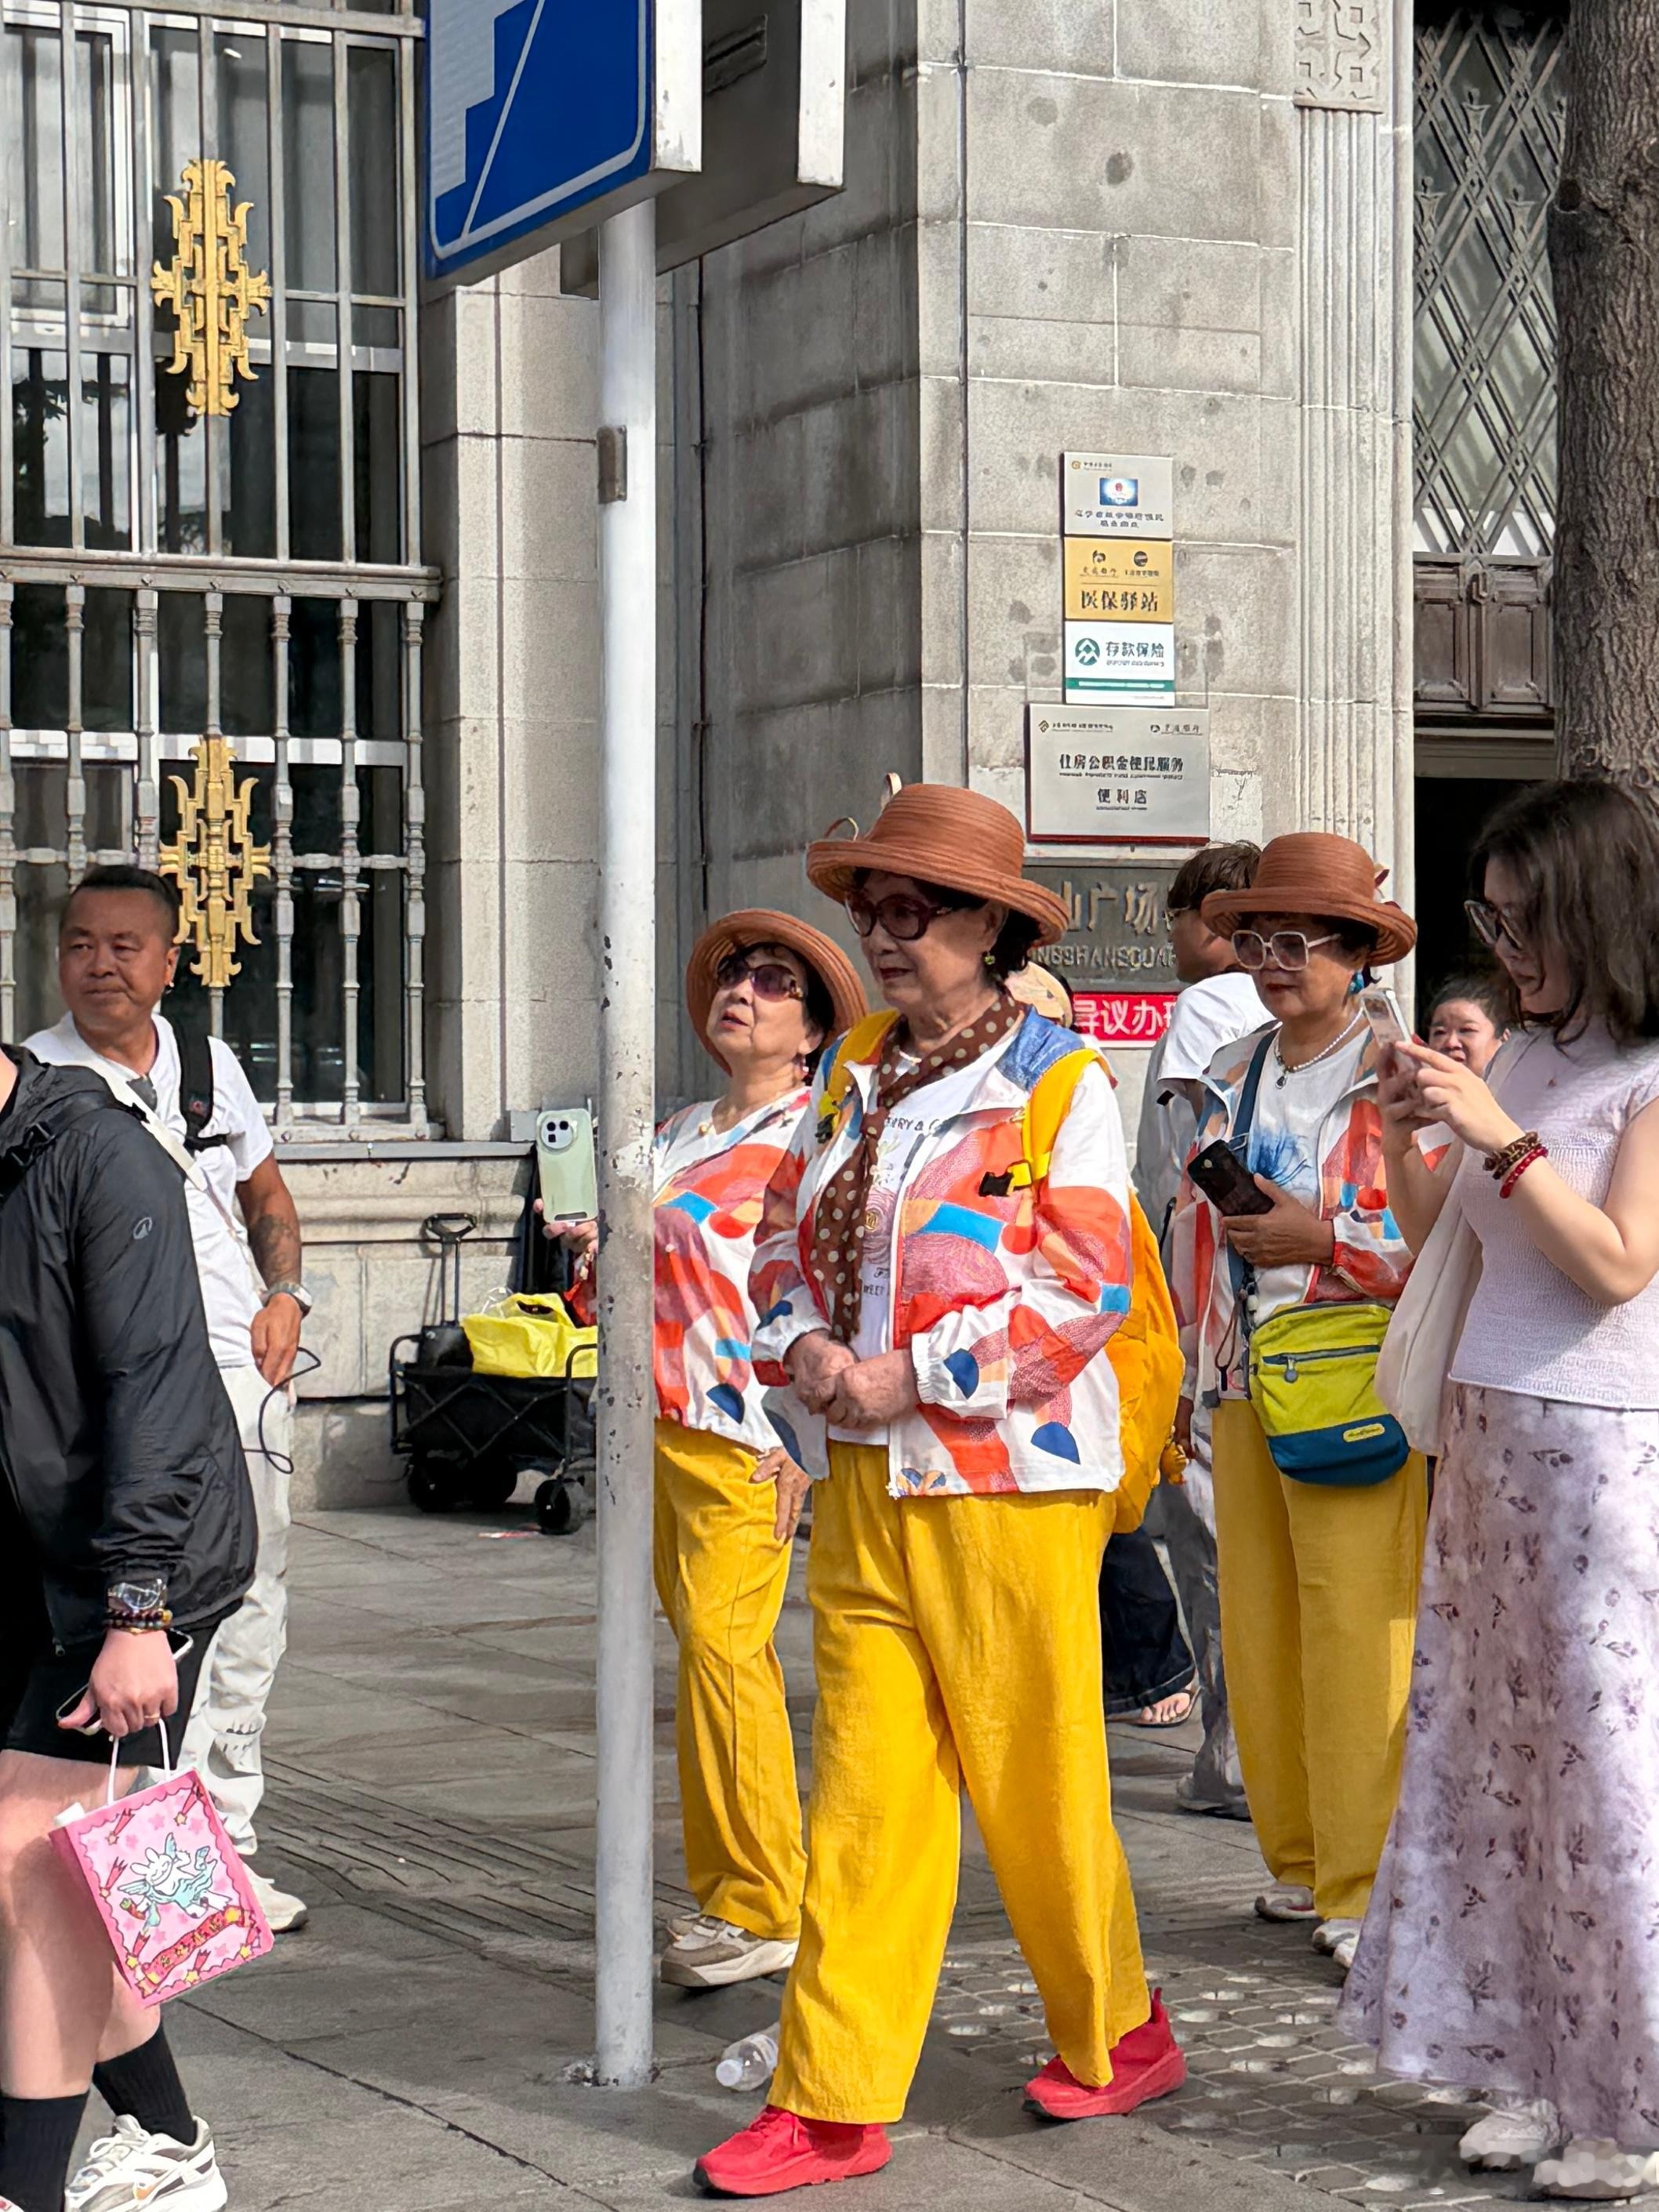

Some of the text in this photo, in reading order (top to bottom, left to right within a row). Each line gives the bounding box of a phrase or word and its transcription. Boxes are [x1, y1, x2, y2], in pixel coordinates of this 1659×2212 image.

[1105, 640, 1164, 659] 存款保险
[1062, 880, 1173, 935] 山广场
